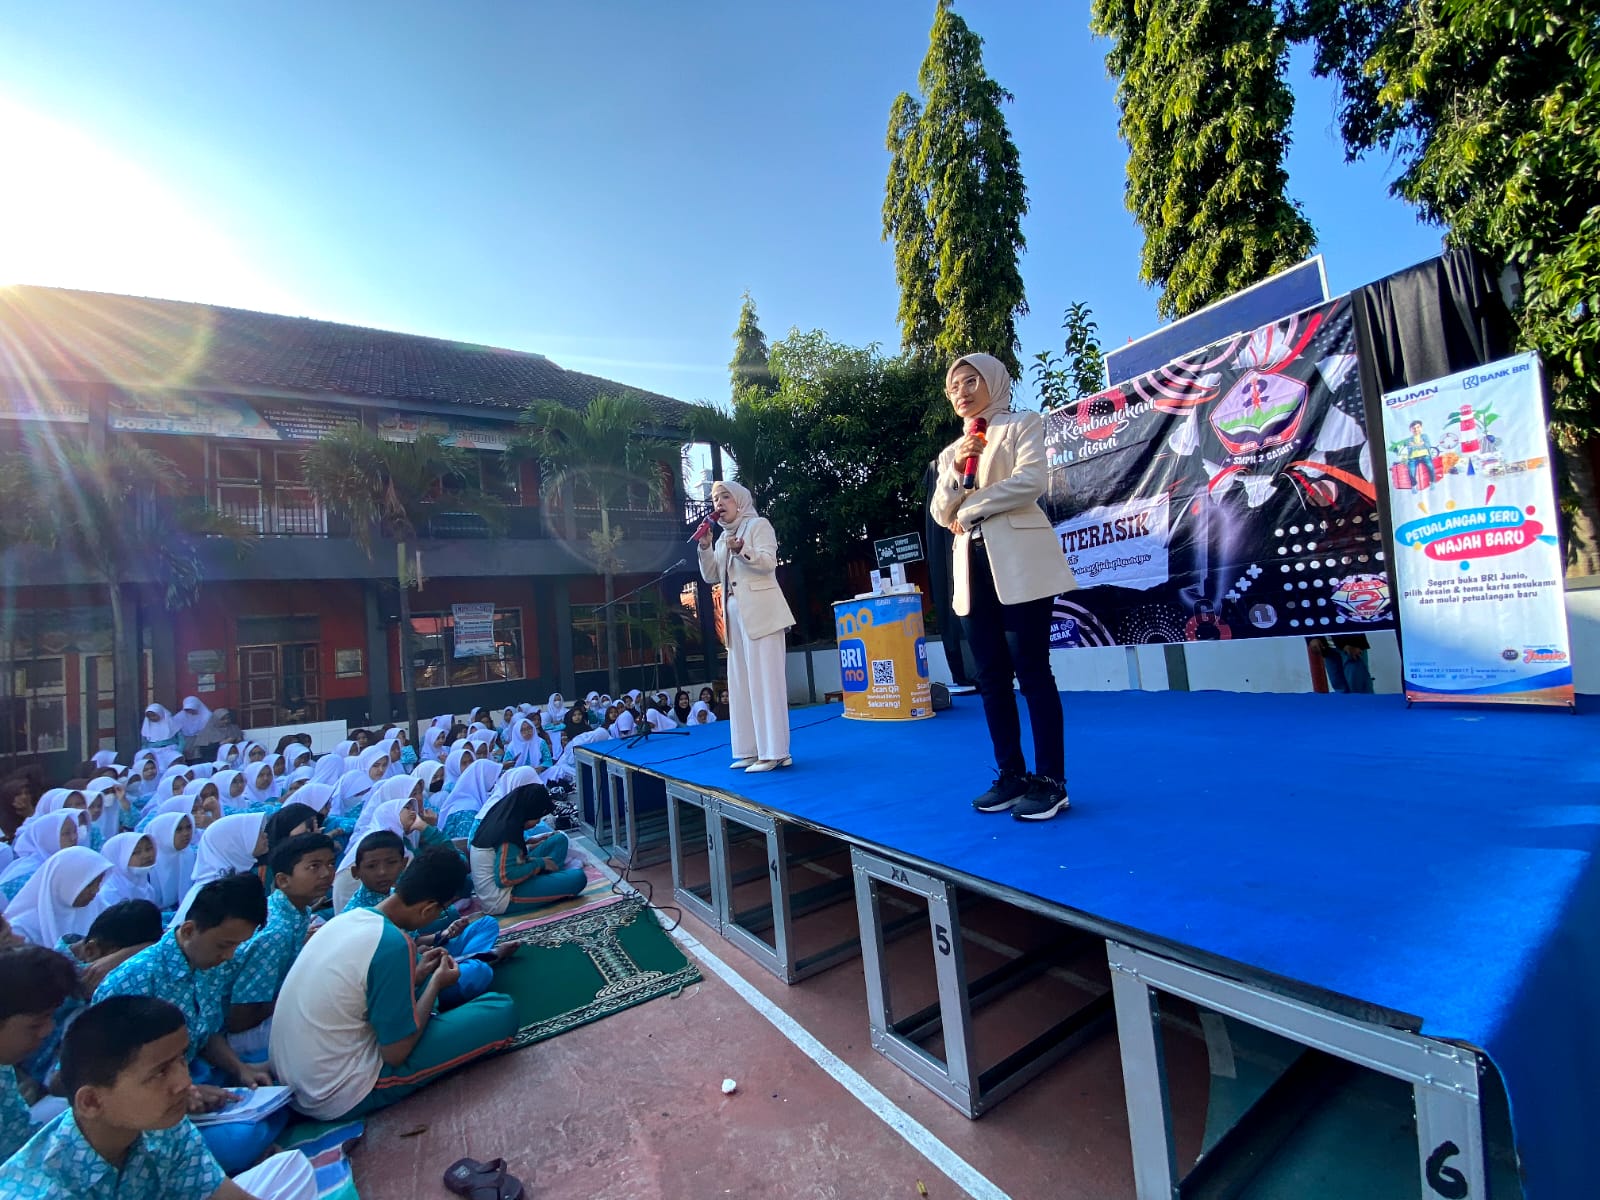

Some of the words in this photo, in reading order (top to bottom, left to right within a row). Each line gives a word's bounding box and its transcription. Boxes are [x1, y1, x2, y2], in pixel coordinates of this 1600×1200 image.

[1480, 369, 1509, 383] BANK
[1512, 363, 1530, 374] BRI
[1386, 386, 1439, 406] BUMN
[1079, 434, 1118, 458] disini
[1258, 454, 1265, 463] 2
[1061, 511, 1150, 554] ITERASIK
[1405, 512, 1487, 543] PETUALANGAN
[1489, 510, 1519, 523] SERU
[1434, 534, 1482, 556] WAJAH
[1485, 529, 1525, 547] BARU
[1404, 590, 1423, 599] pilih
[1425, 588, 1451, 596] desain
[1453, 586, 1460, 594] &
[1486, 583, 1510, 591] kartu
[1512, 579, 1557, 589] sesukamu
[1427, 579, 1455, 588] Segera
[1457, 576, 1478, 584] buka
[1480, 574, 1498, 582] BRI
[1349, 590, 1381, 611] 2
[1436, 595, 1460, 604] mulai
[1462, 592, 1515, 603] petualangan
[1517, 590, 1538, 598] baru
[1050, 629, 1071, 641] GERAK
[840, 647, 863, 668] BRI
[845, 670, 864, 682] mo
[708, 834, 714, 851] 3
[770, 859, 778, 881] 4
[935, 924, 951, 956] 5
[1426, 1140, 1468, 1199] 6
